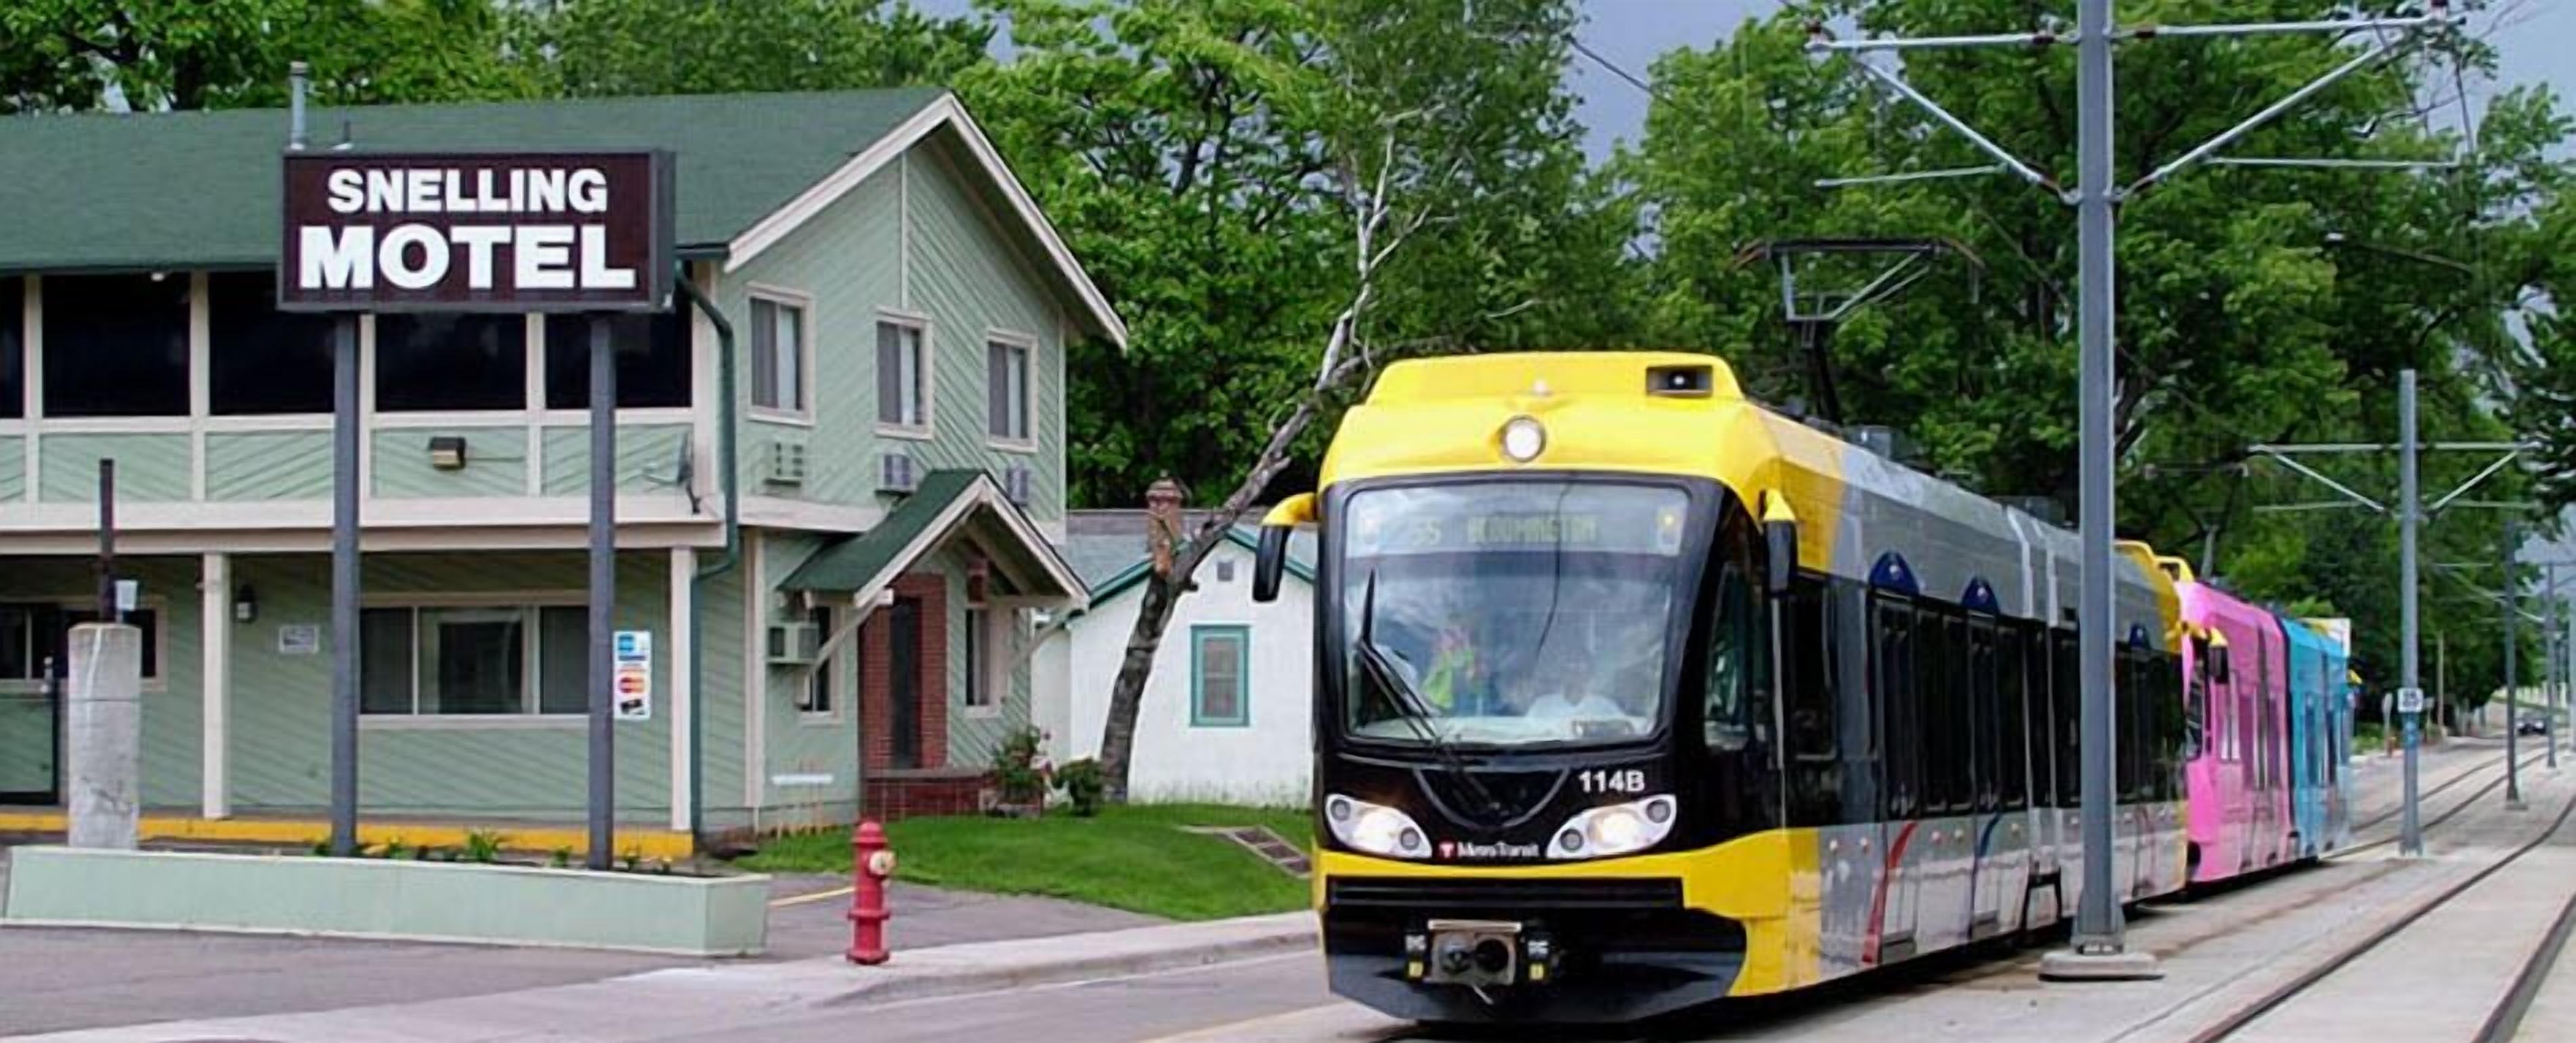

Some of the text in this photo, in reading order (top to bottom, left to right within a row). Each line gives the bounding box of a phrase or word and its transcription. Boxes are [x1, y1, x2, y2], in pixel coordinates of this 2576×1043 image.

[328, 168, 607, 213] SNELLING
[299, 224, 636, 289] MOTEL
[1579, 769, 1645, 792] 114B
